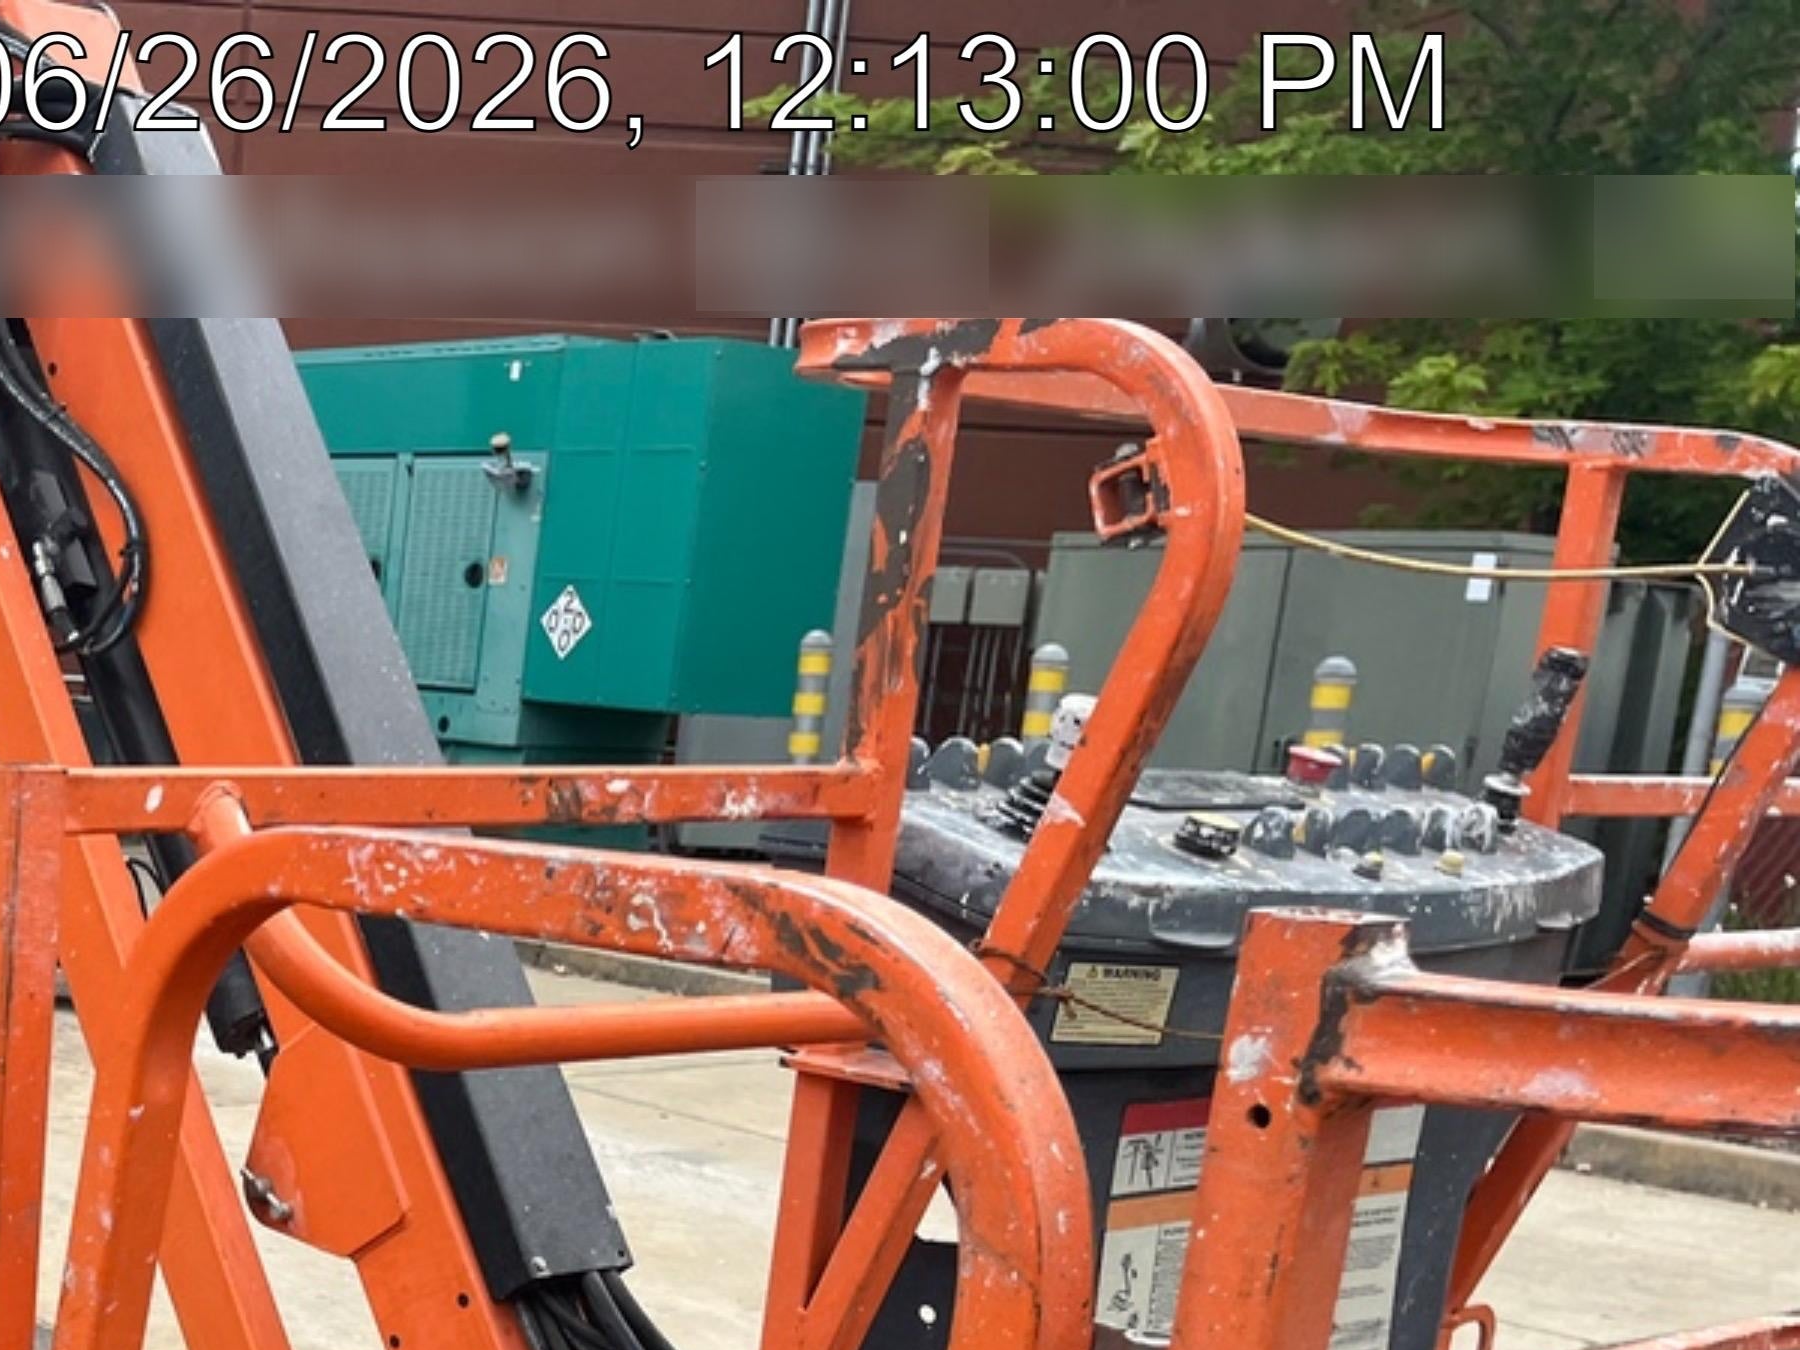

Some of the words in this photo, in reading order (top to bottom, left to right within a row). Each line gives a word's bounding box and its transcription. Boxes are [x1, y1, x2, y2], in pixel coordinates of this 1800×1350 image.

[563, 591, 574, 612] 2
[547, 609, 558, 633] 0
[573, 612, 585, 633] 0
[558, 629, 570, 652] 0
[1102, 967, 1162, 981] WARNING
